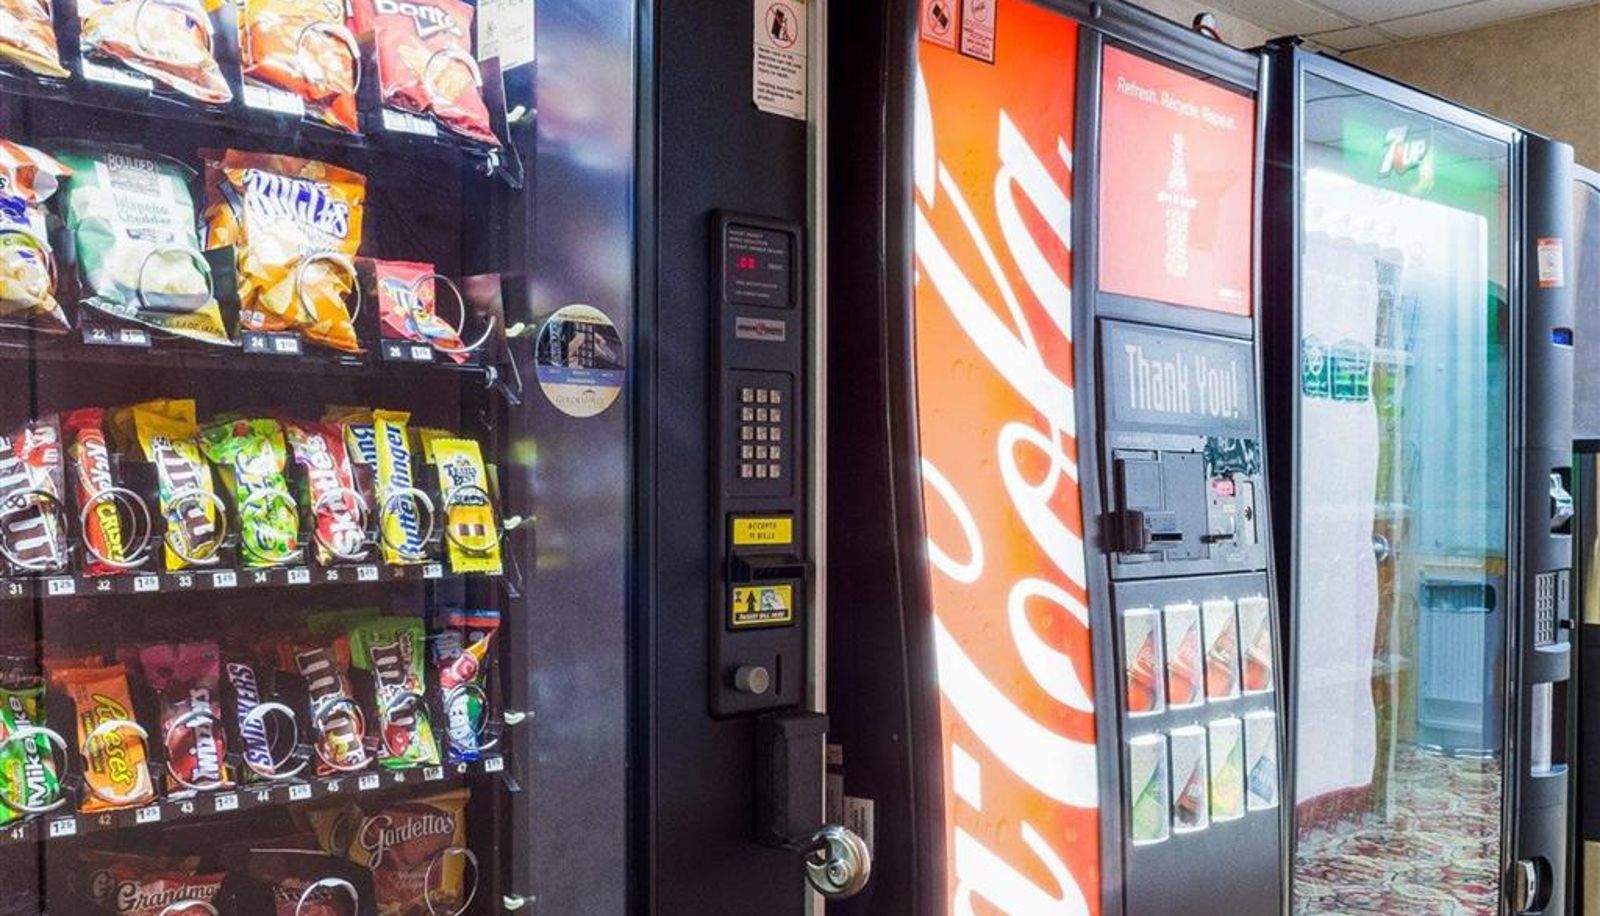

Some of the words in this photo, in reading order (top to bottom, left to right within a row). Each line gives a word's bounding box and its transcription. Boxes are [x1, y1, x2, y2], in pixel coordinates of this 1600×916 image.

[1125, 344, 1191, 413] Thank
[1195, 355, 1240, 420] You!
[385, 423, 420, 554] Butterfinger
[9, 583, 23, 595] 31
[97, 580, 111, 591] 32
[178, 576, 192, 587] 33
[254, 572, 267, 583] 34
[326, 569, 339, 580] 35
[227, 662, 273, 767] SNICKERS
[24, 737, 47, 808] Mike
[10, 827, 24, 839] 41
[99, 814, 112, 825] 42
[181, 802, 194, 813] 43
[257, 791, 270, 801] 44
[327, 781, 340, 792] 45
[360, 812, 455, 872] Gardetto's
